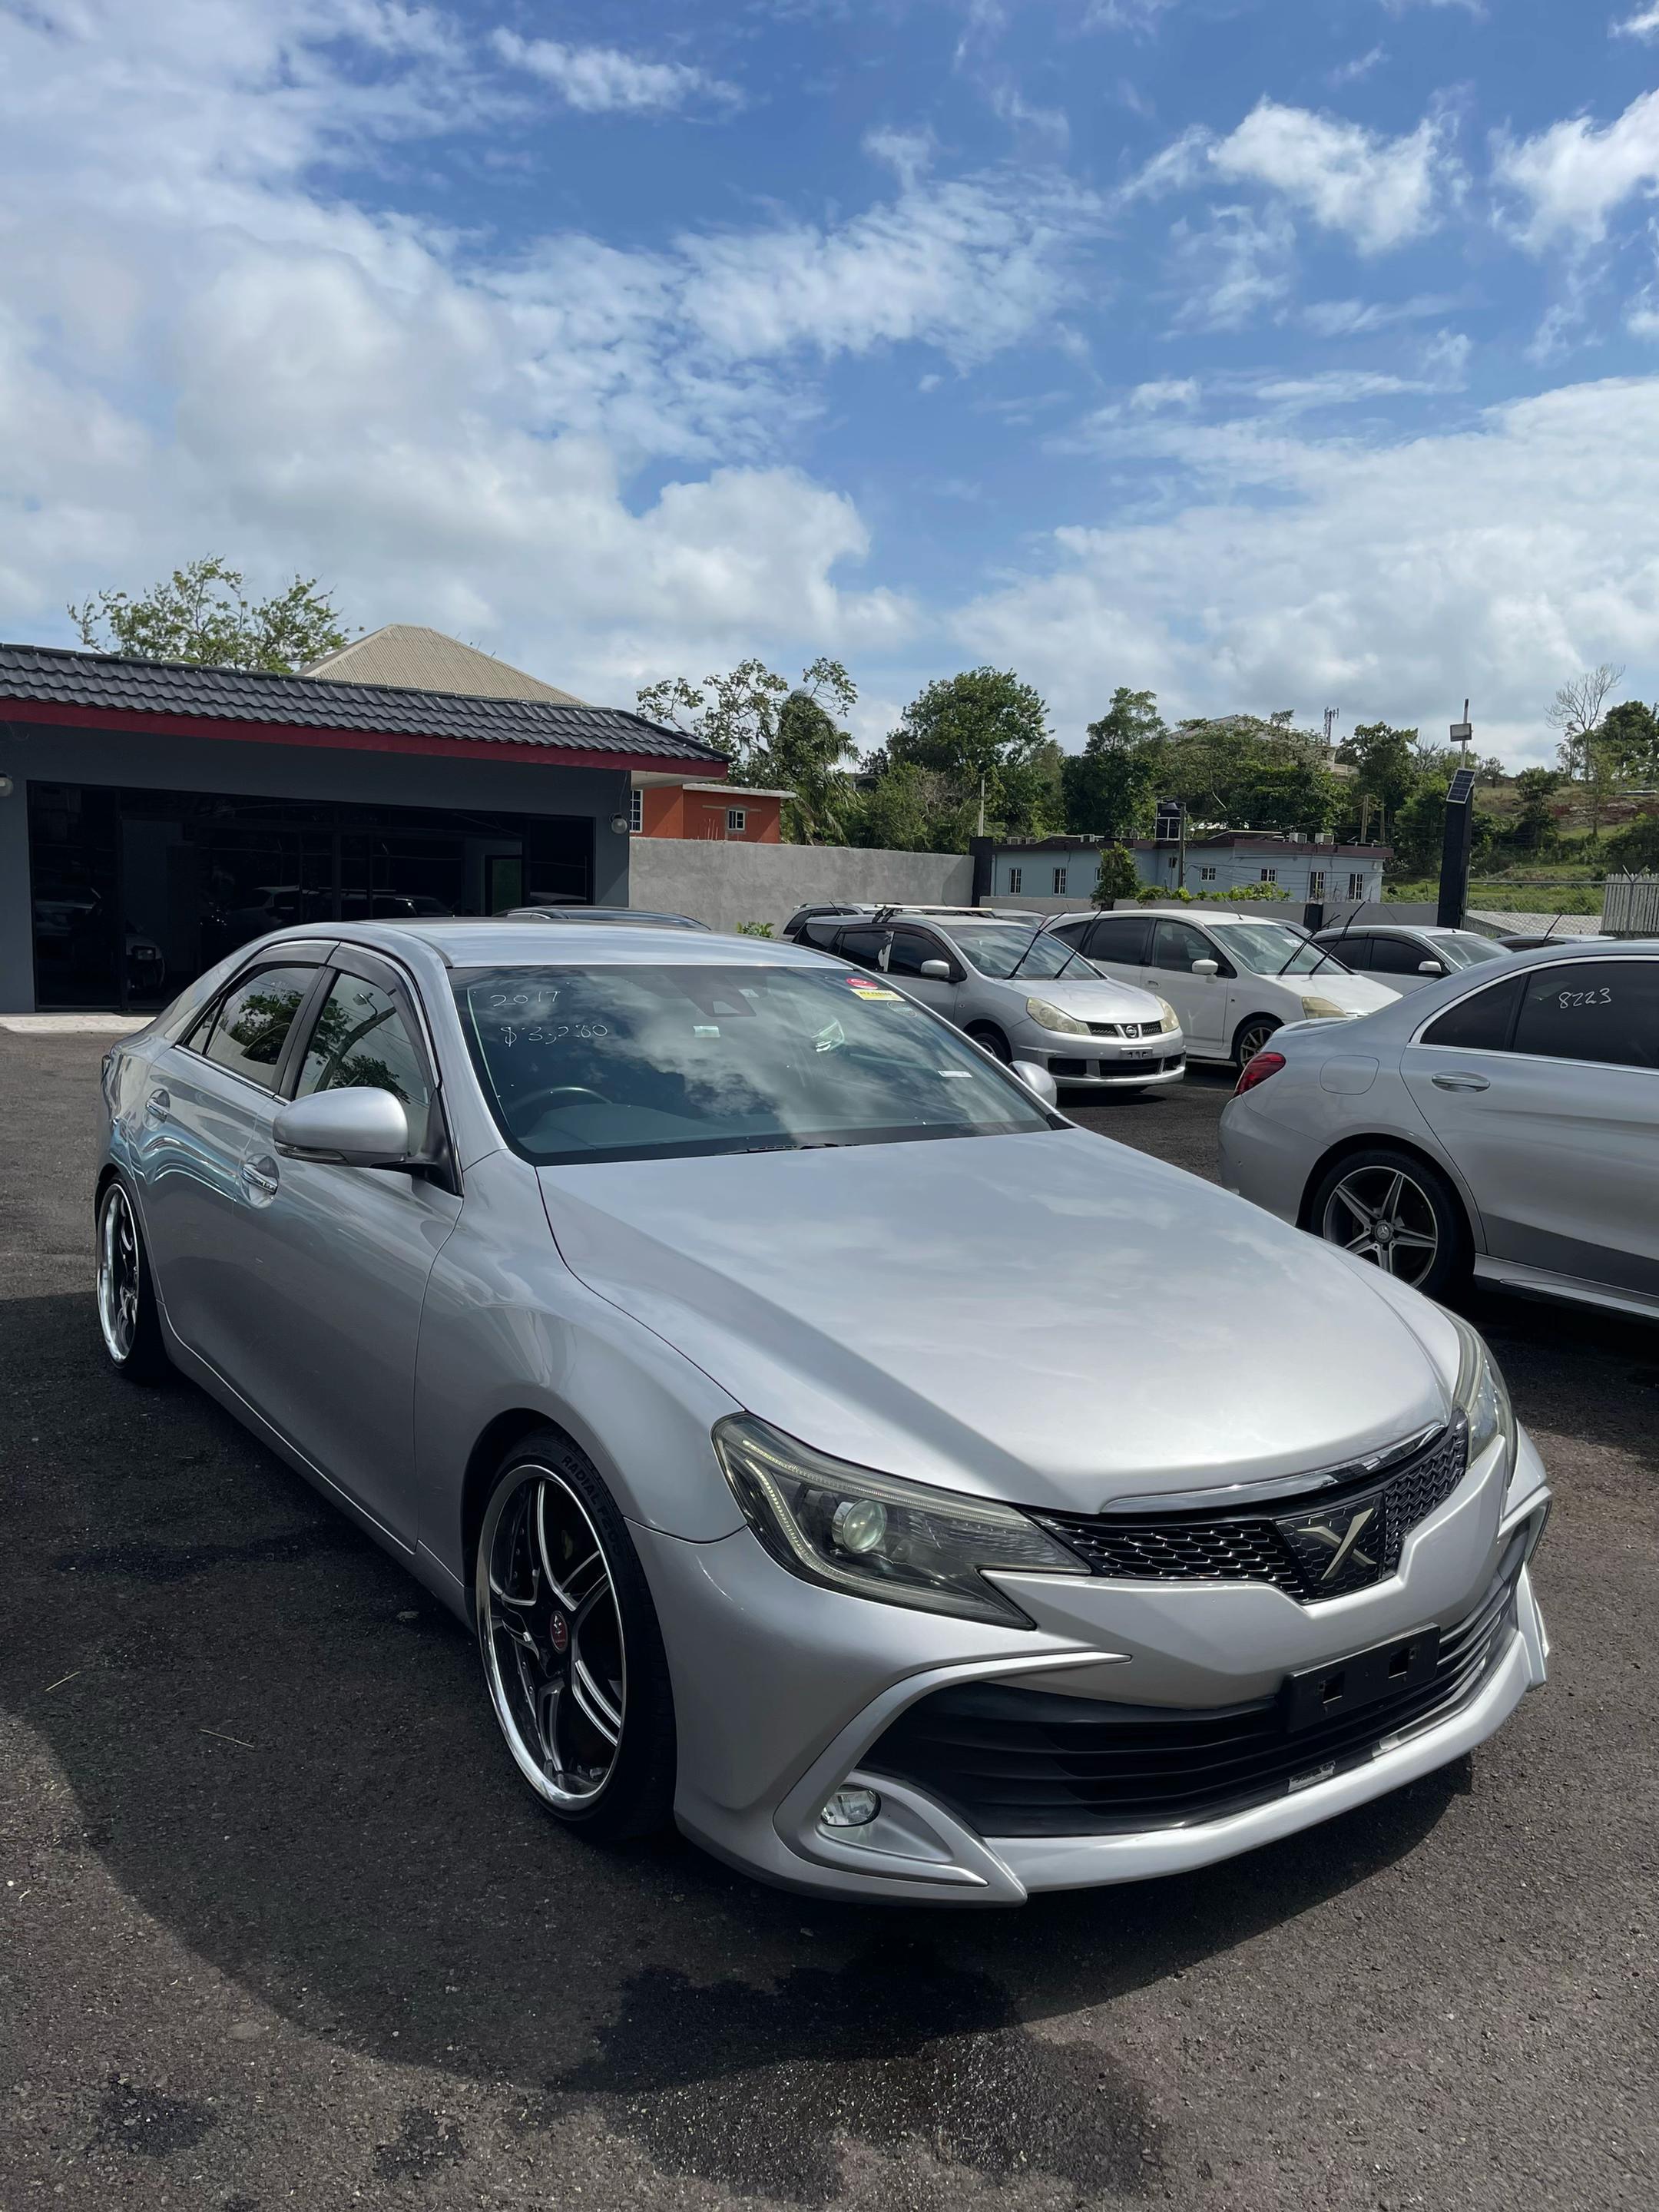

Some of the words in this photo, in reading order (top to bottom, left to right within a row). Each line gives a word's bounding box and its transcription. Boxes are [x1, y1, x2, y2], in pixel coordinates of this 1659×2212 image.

[490, 990, 561, 1007] 2017
[1558, 988, 1611, 1008] 8223
[561, 1455, 600, 1505] RADIAL
